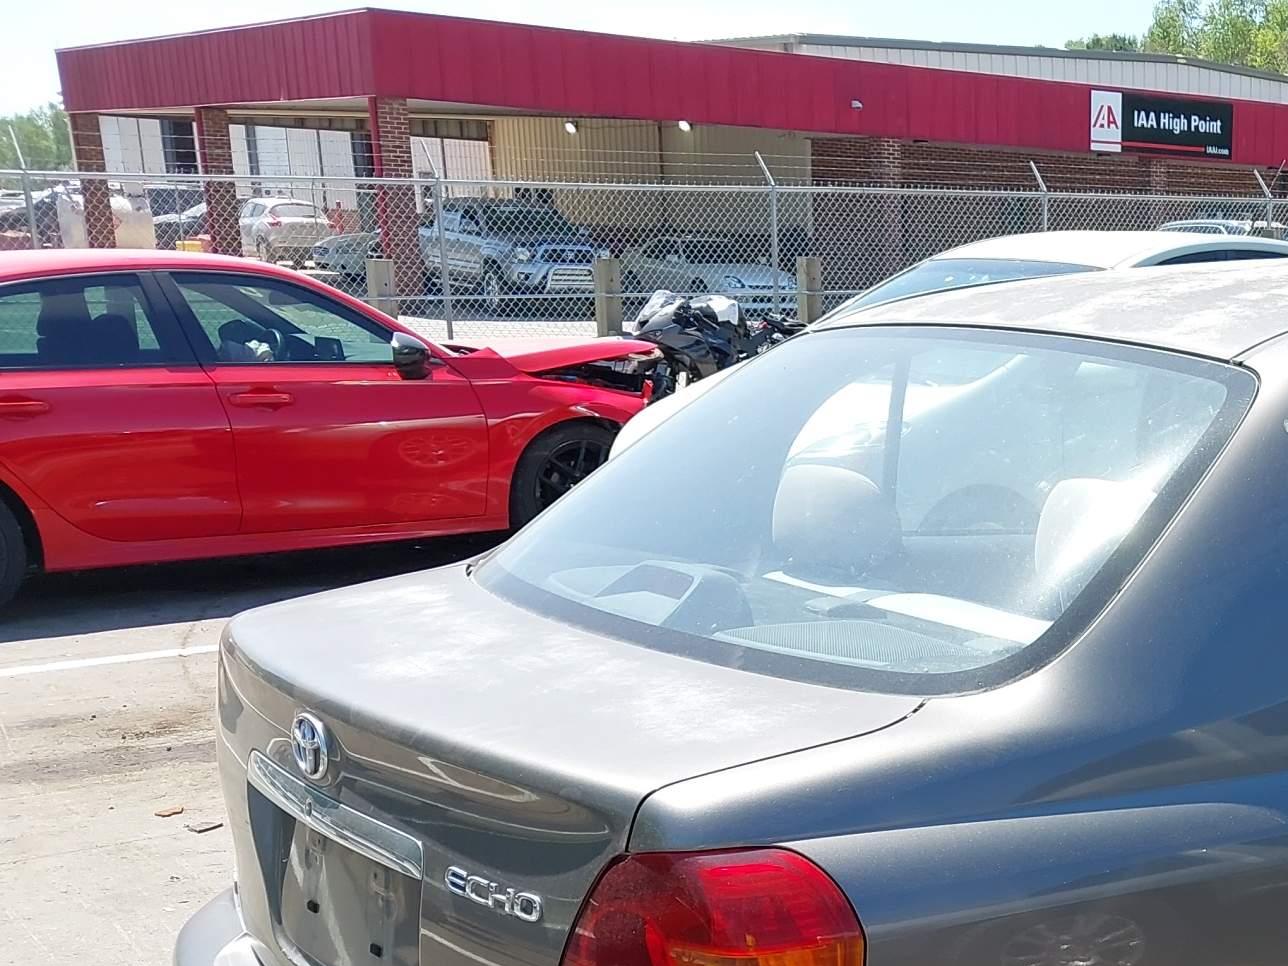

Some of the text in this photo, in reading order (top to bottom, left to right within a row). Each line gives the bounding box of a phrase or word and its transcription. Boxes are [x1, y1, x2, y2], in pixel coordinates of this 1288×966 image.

[1133, 110, 1222, 134] IAA High Point
[444, 865, 543, 922] ECHO
